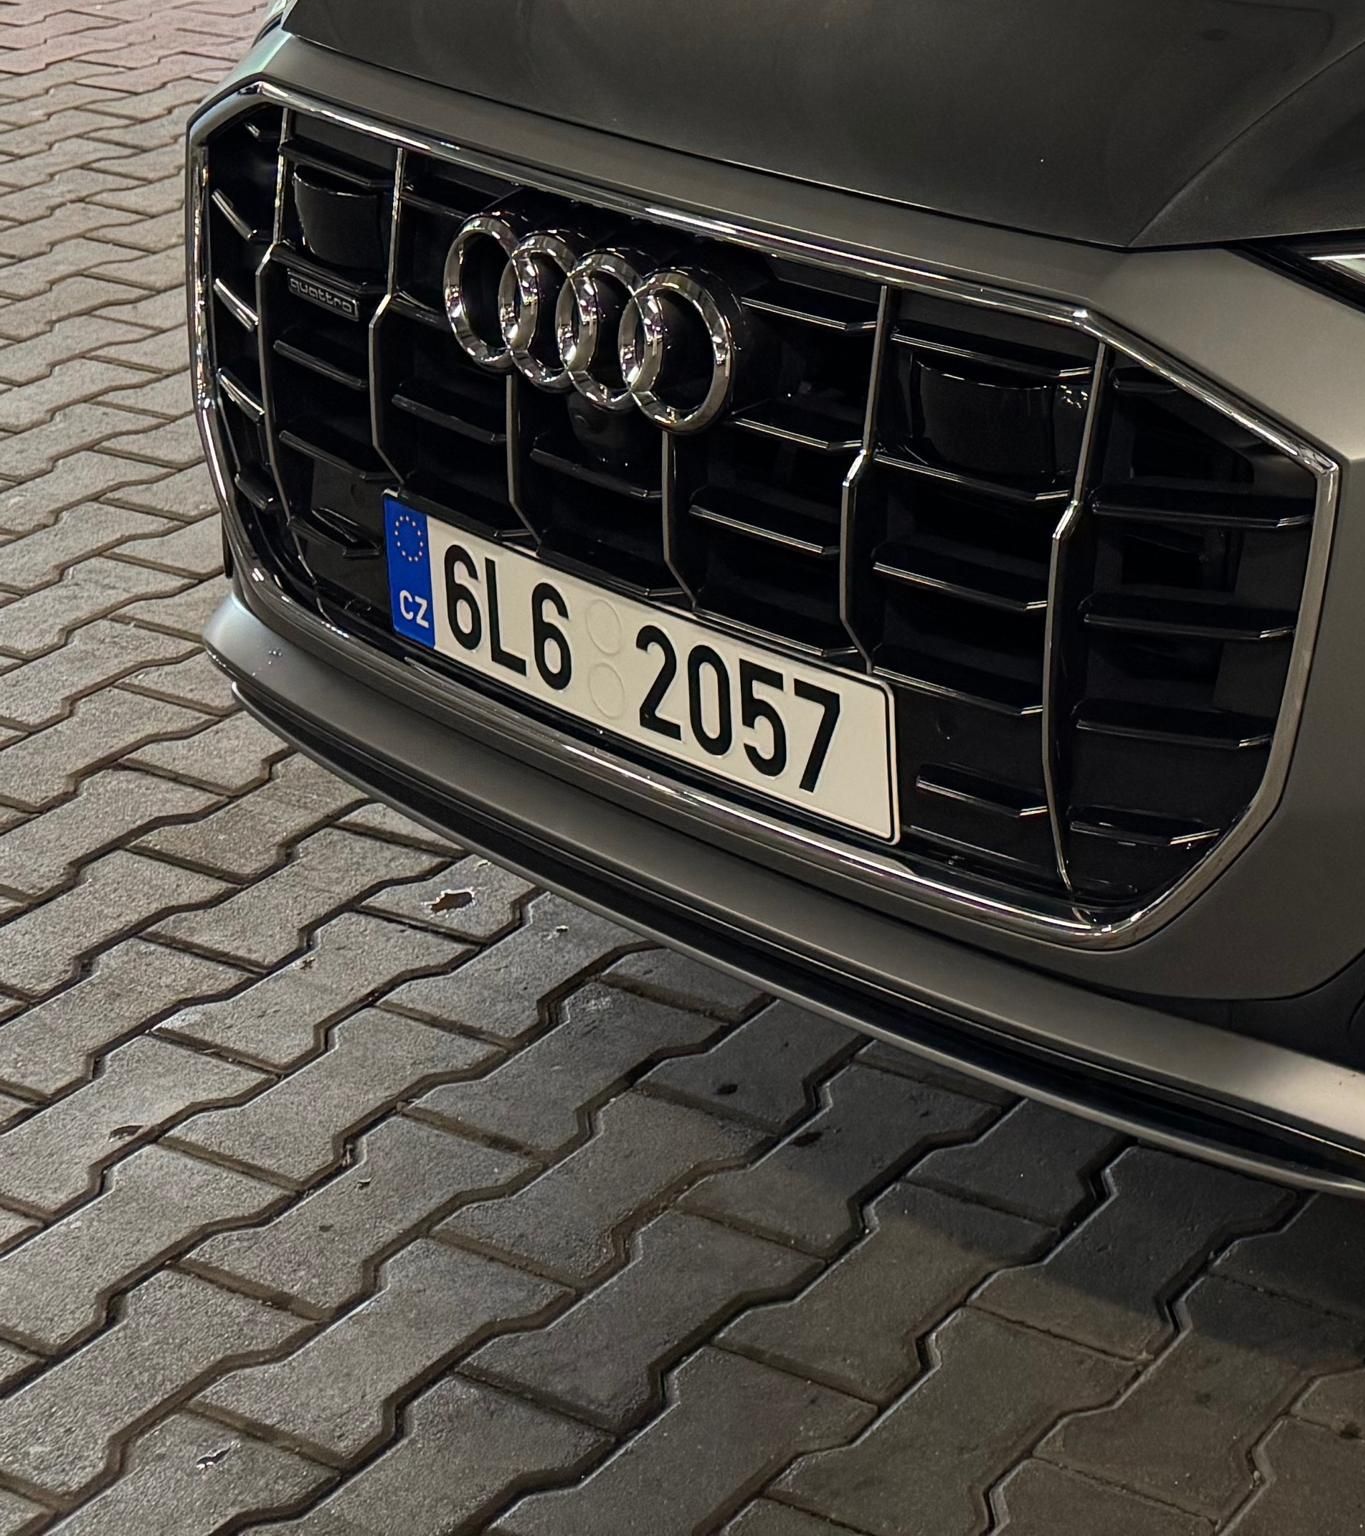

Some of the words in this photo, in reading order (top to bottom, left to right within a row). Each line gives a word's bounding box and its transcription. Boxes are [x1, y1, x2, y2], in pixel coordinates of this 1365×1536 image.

[289, 277, 353, 314] quattro
[399, 590, 430, 629] CZ
[443, 543, 573, 692] 6L6
[634, 624, 841, 794] 2057
